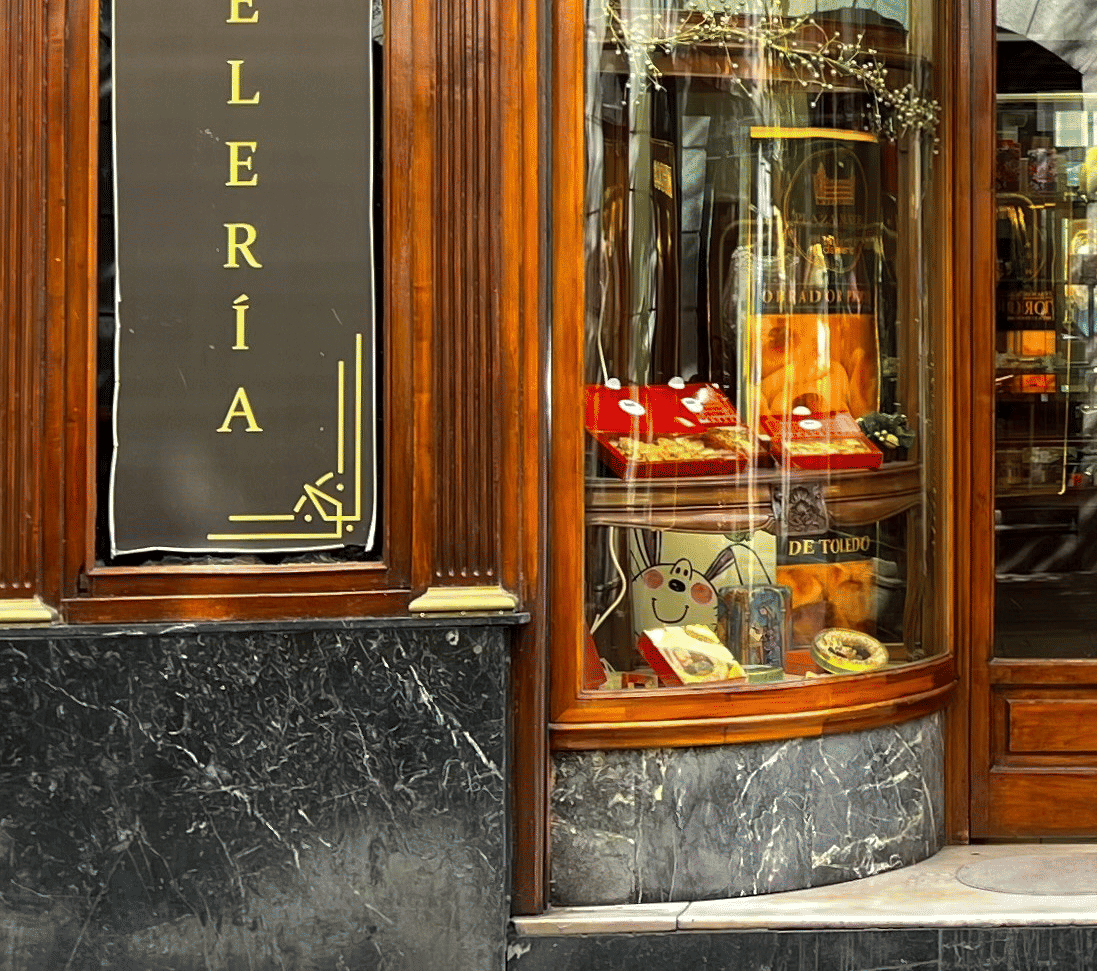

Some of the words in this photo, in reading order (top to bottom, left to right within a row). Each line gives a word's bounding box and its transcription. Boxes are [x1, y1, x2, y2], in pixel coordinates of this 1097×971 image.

[762, 289, 843, 304] OADOR
[788, 539, 815, 556] DE
[819, 535, 871, 555] TOLEDO
